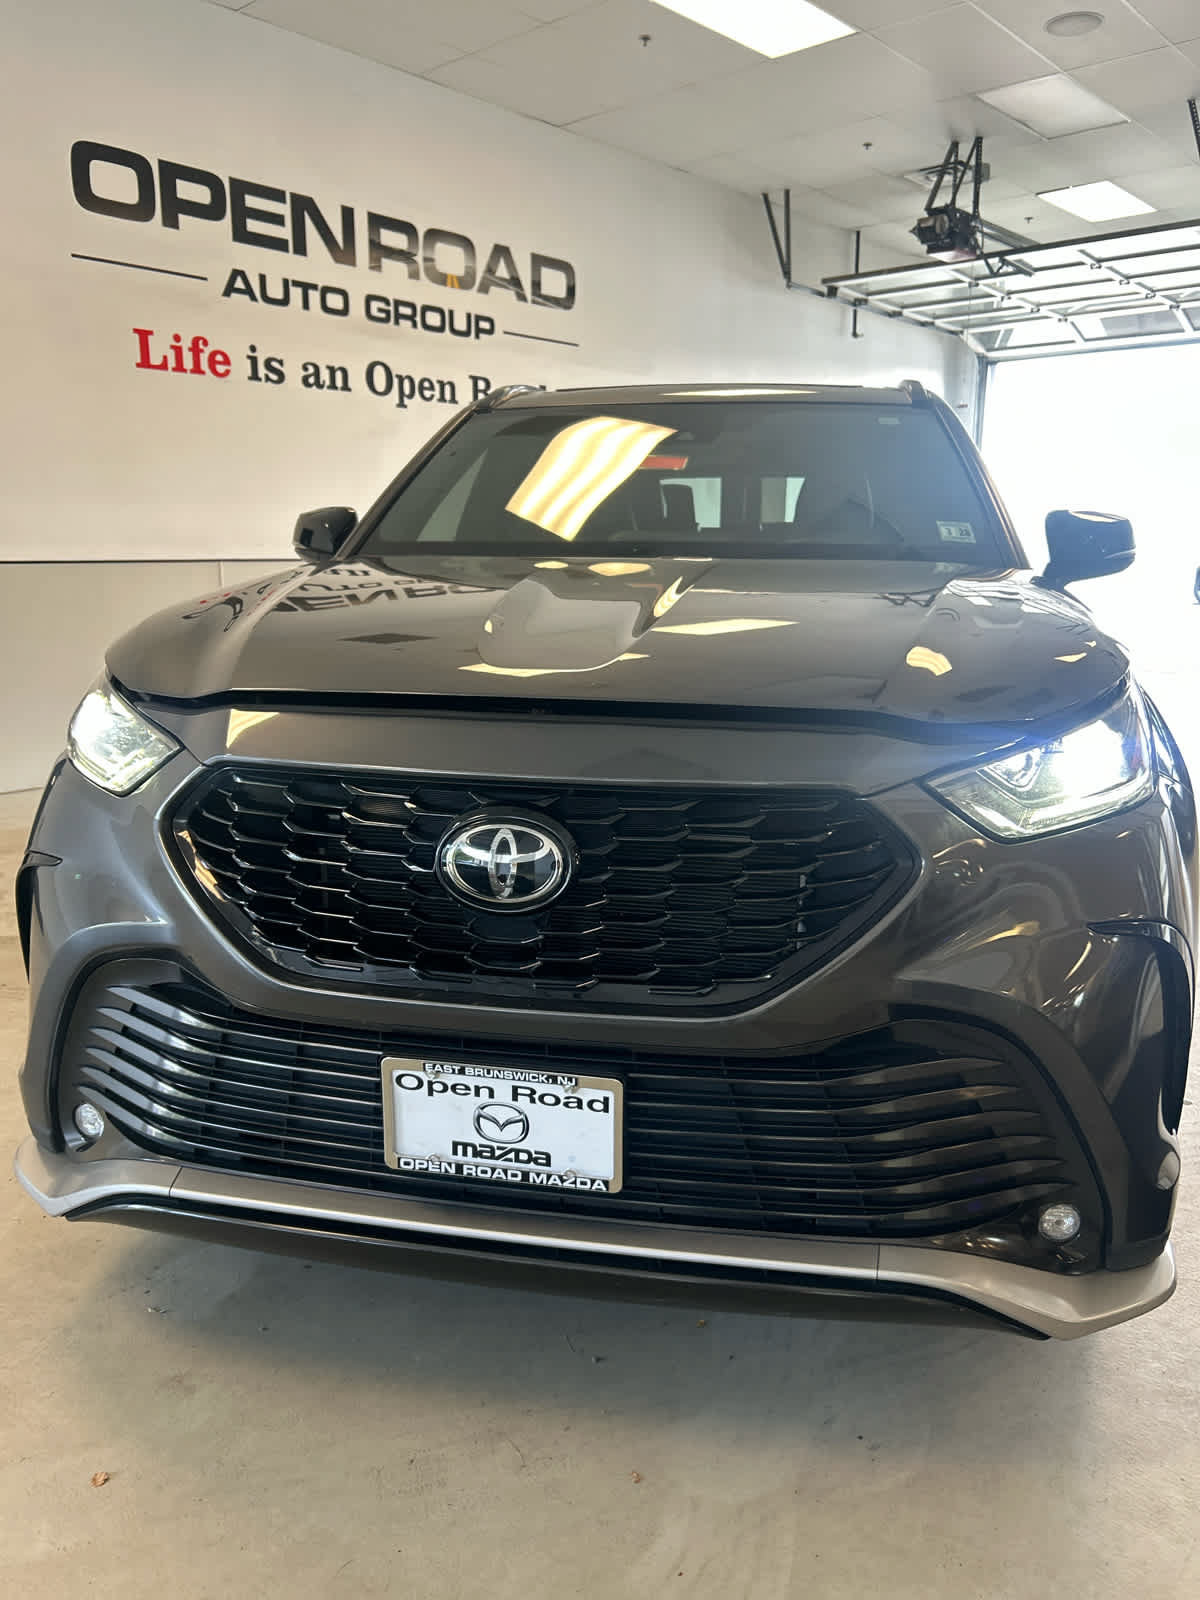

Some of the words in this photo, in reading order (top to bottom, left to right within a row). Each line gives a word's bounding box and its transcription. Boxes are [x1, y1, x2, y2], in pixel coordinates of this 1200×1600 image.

[70, 140, 357, 268] OPEN
[367, 210, 576, 311] ROAD
[222, 268, 350, 317] AUTO
[364, 294, 496, 340] GROUP
[132, 328, 232, 378] Life
[246, 345, 286, 385] is
[301, 360, 351, 392] an
[365, 360, 459, 408] Open
[395, 1073, 495, 1099] Open
[511, 1085, 610, 1113] Road
[424, 1063, 461, 1075] EAST
[465, 1067, 553, 1084] BRUNSWICK,
[557, 1076, 576, 1087] NJ
[452, 1140, 552, 1168] mazda
[400, 1158, 456, 1174] OPEN
[462, 1164, 522, 1182] ROAD
[528, 1170, 607, 1192] MAZDA
